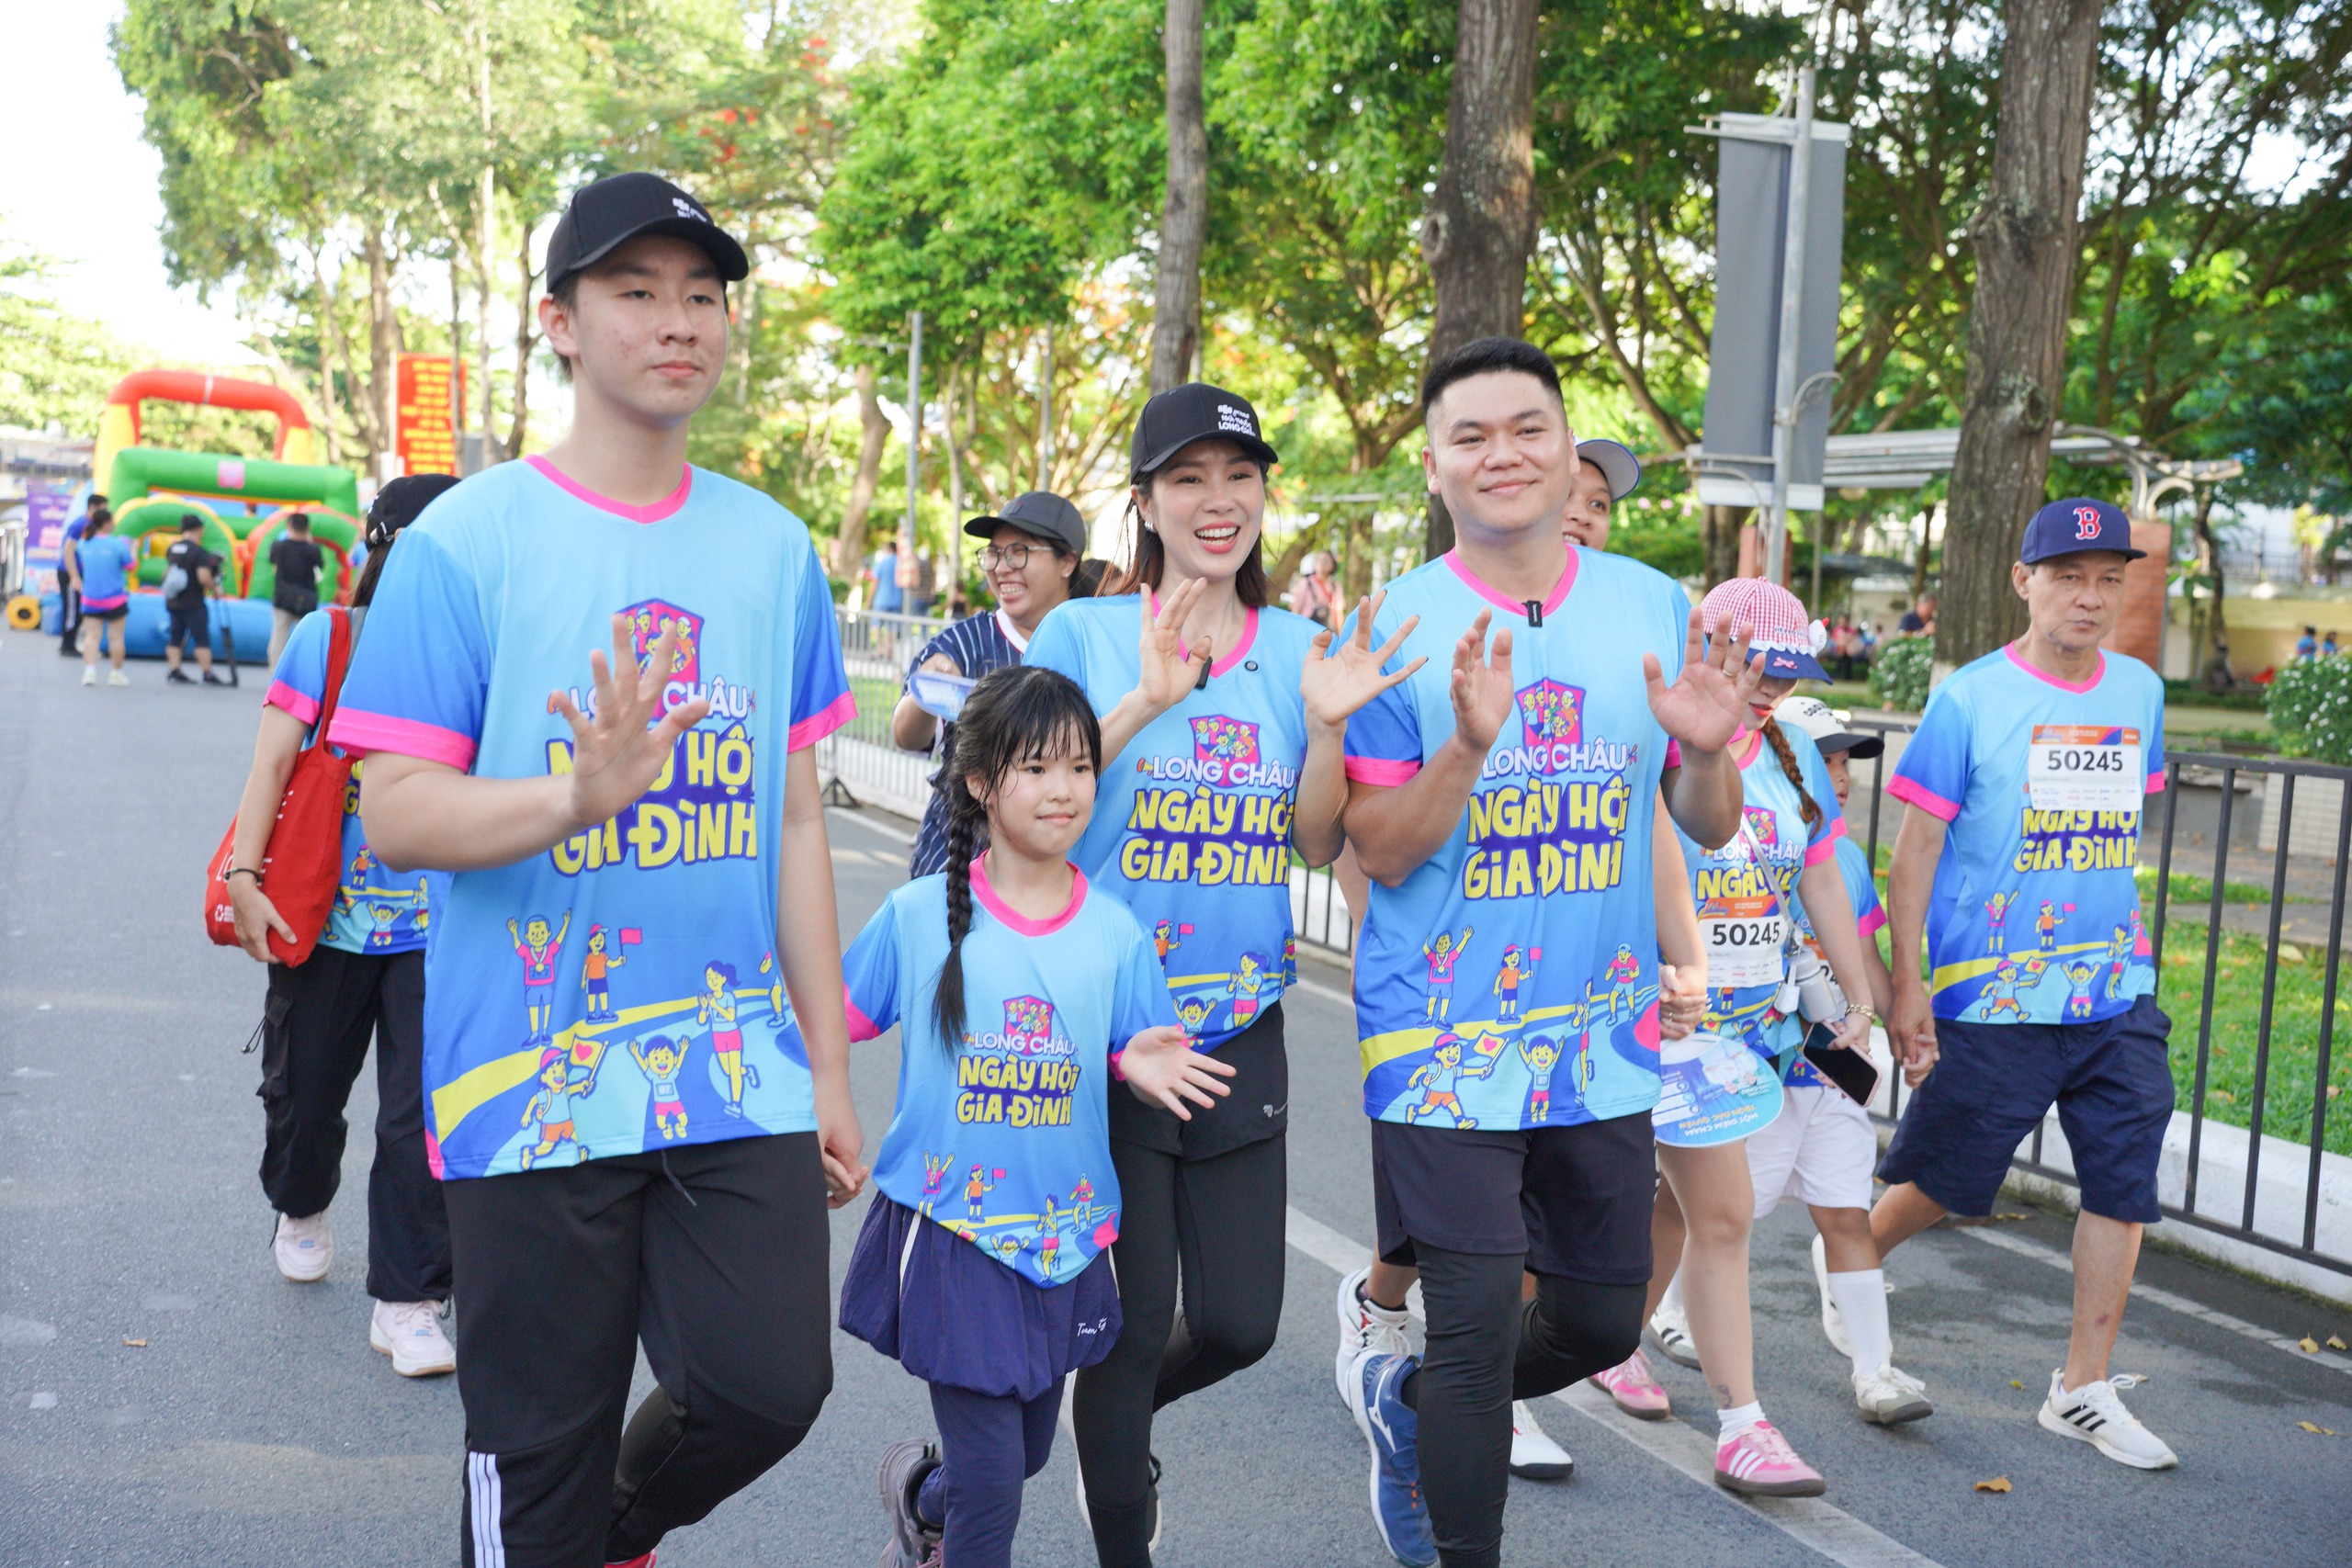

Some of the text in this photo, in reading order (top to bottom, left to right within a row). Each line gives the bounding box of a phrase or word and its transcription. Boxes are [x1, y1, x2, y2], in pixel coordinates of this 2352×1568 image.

[2073, 506, 2102, 540] B
[1153, 756, 1295, 789] LONG CHÂU
[1483, 736, 1628, 780] LONG CHÂU
[2047, 750, 2123, 772] 50245
[1127, 784, 1238, 836] NGÀY
[1711, 921, 1781, 946] 50245
[974, 1032, 1076, 1055] LONG CHÂU
[958, 1054, 1037, 1091] NGÀY
